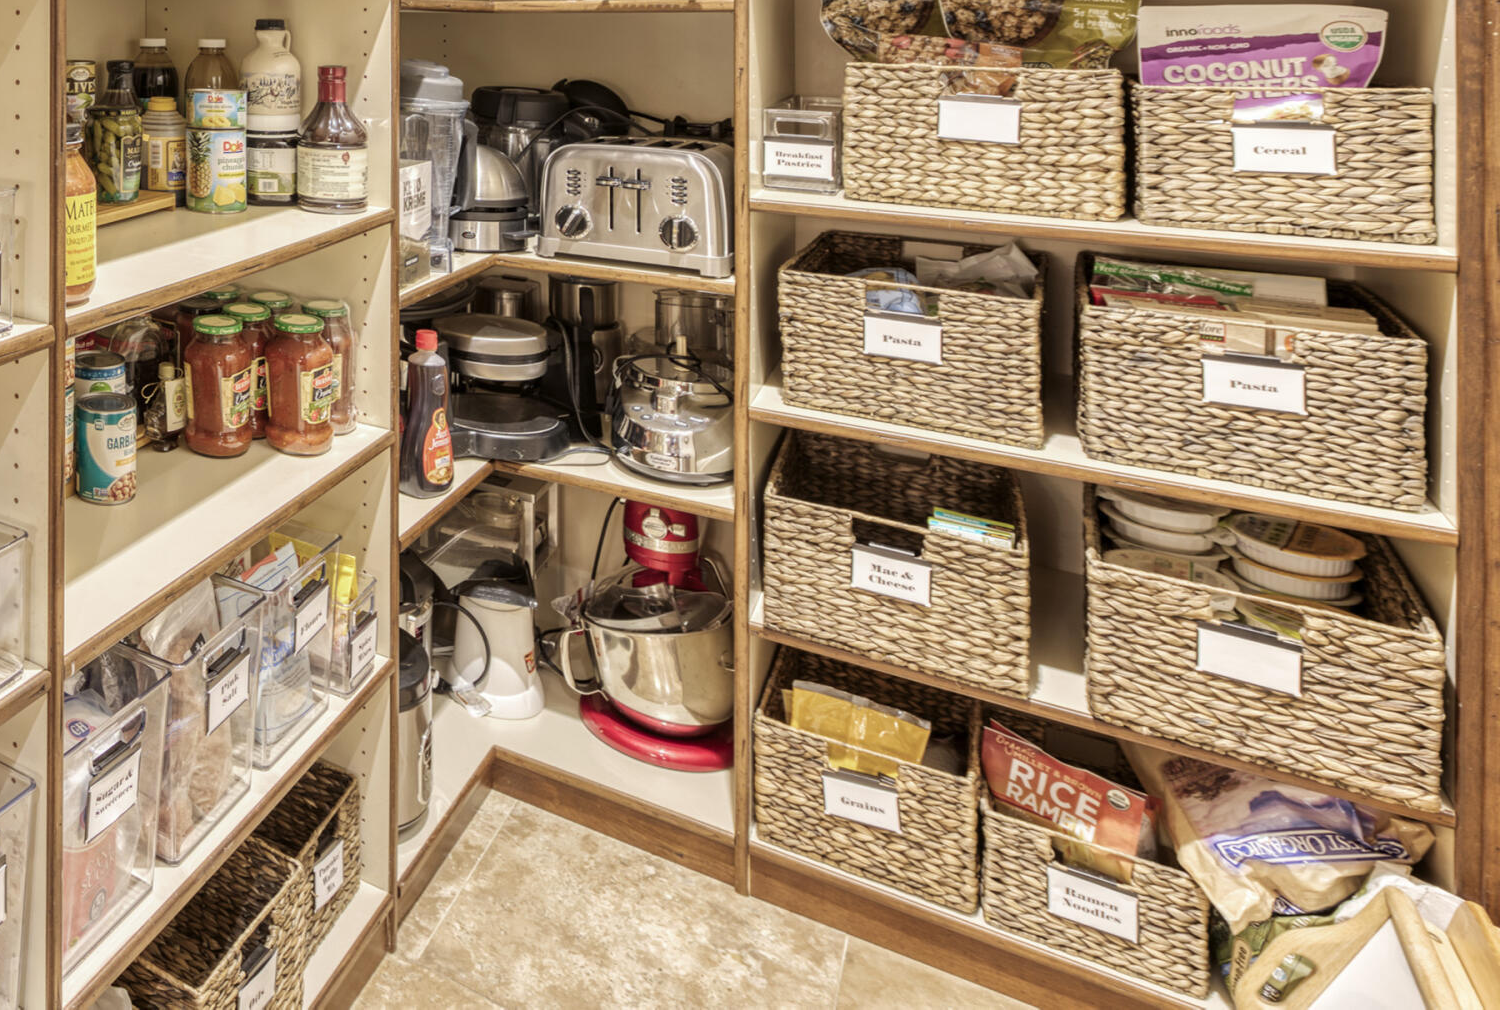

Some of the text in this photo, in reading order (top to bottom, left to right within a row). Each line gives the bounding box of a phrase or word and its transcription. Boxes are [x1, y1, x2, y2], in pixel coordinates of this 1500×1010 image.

[1165, 24, 1242, 37] innofoods
[1164, 57, 1308, 84] COCONUT
[223, 141, 244, 152] Dole
[775, 151, 824, 159] Breakfast
[1252, 143, 1308, 158] Cereal
[777, 159, 822, 168] Pastries
[882, 334, 923, 349] Pasta
[1229, 379, 1279, 393] Pasta
[870, 562, 914, 581] Mac &
[868, 574, 916, 592] Cheese
[995, 735, 1038, 758] Organic
[1012, 751, 1053, 773] MILLET
[1052, 769, 1062, 779] &
[1008, 757, 1101, 826] RICE
[840, 795, 887, 816] Grains
[1005, 780, 1097, 844] RAMEN
[1231, 835, 1327, 861] ORGANICS
[1064, 886, 1120, 913] Ramen
[1062, 896, 1123, 925] Noodles
